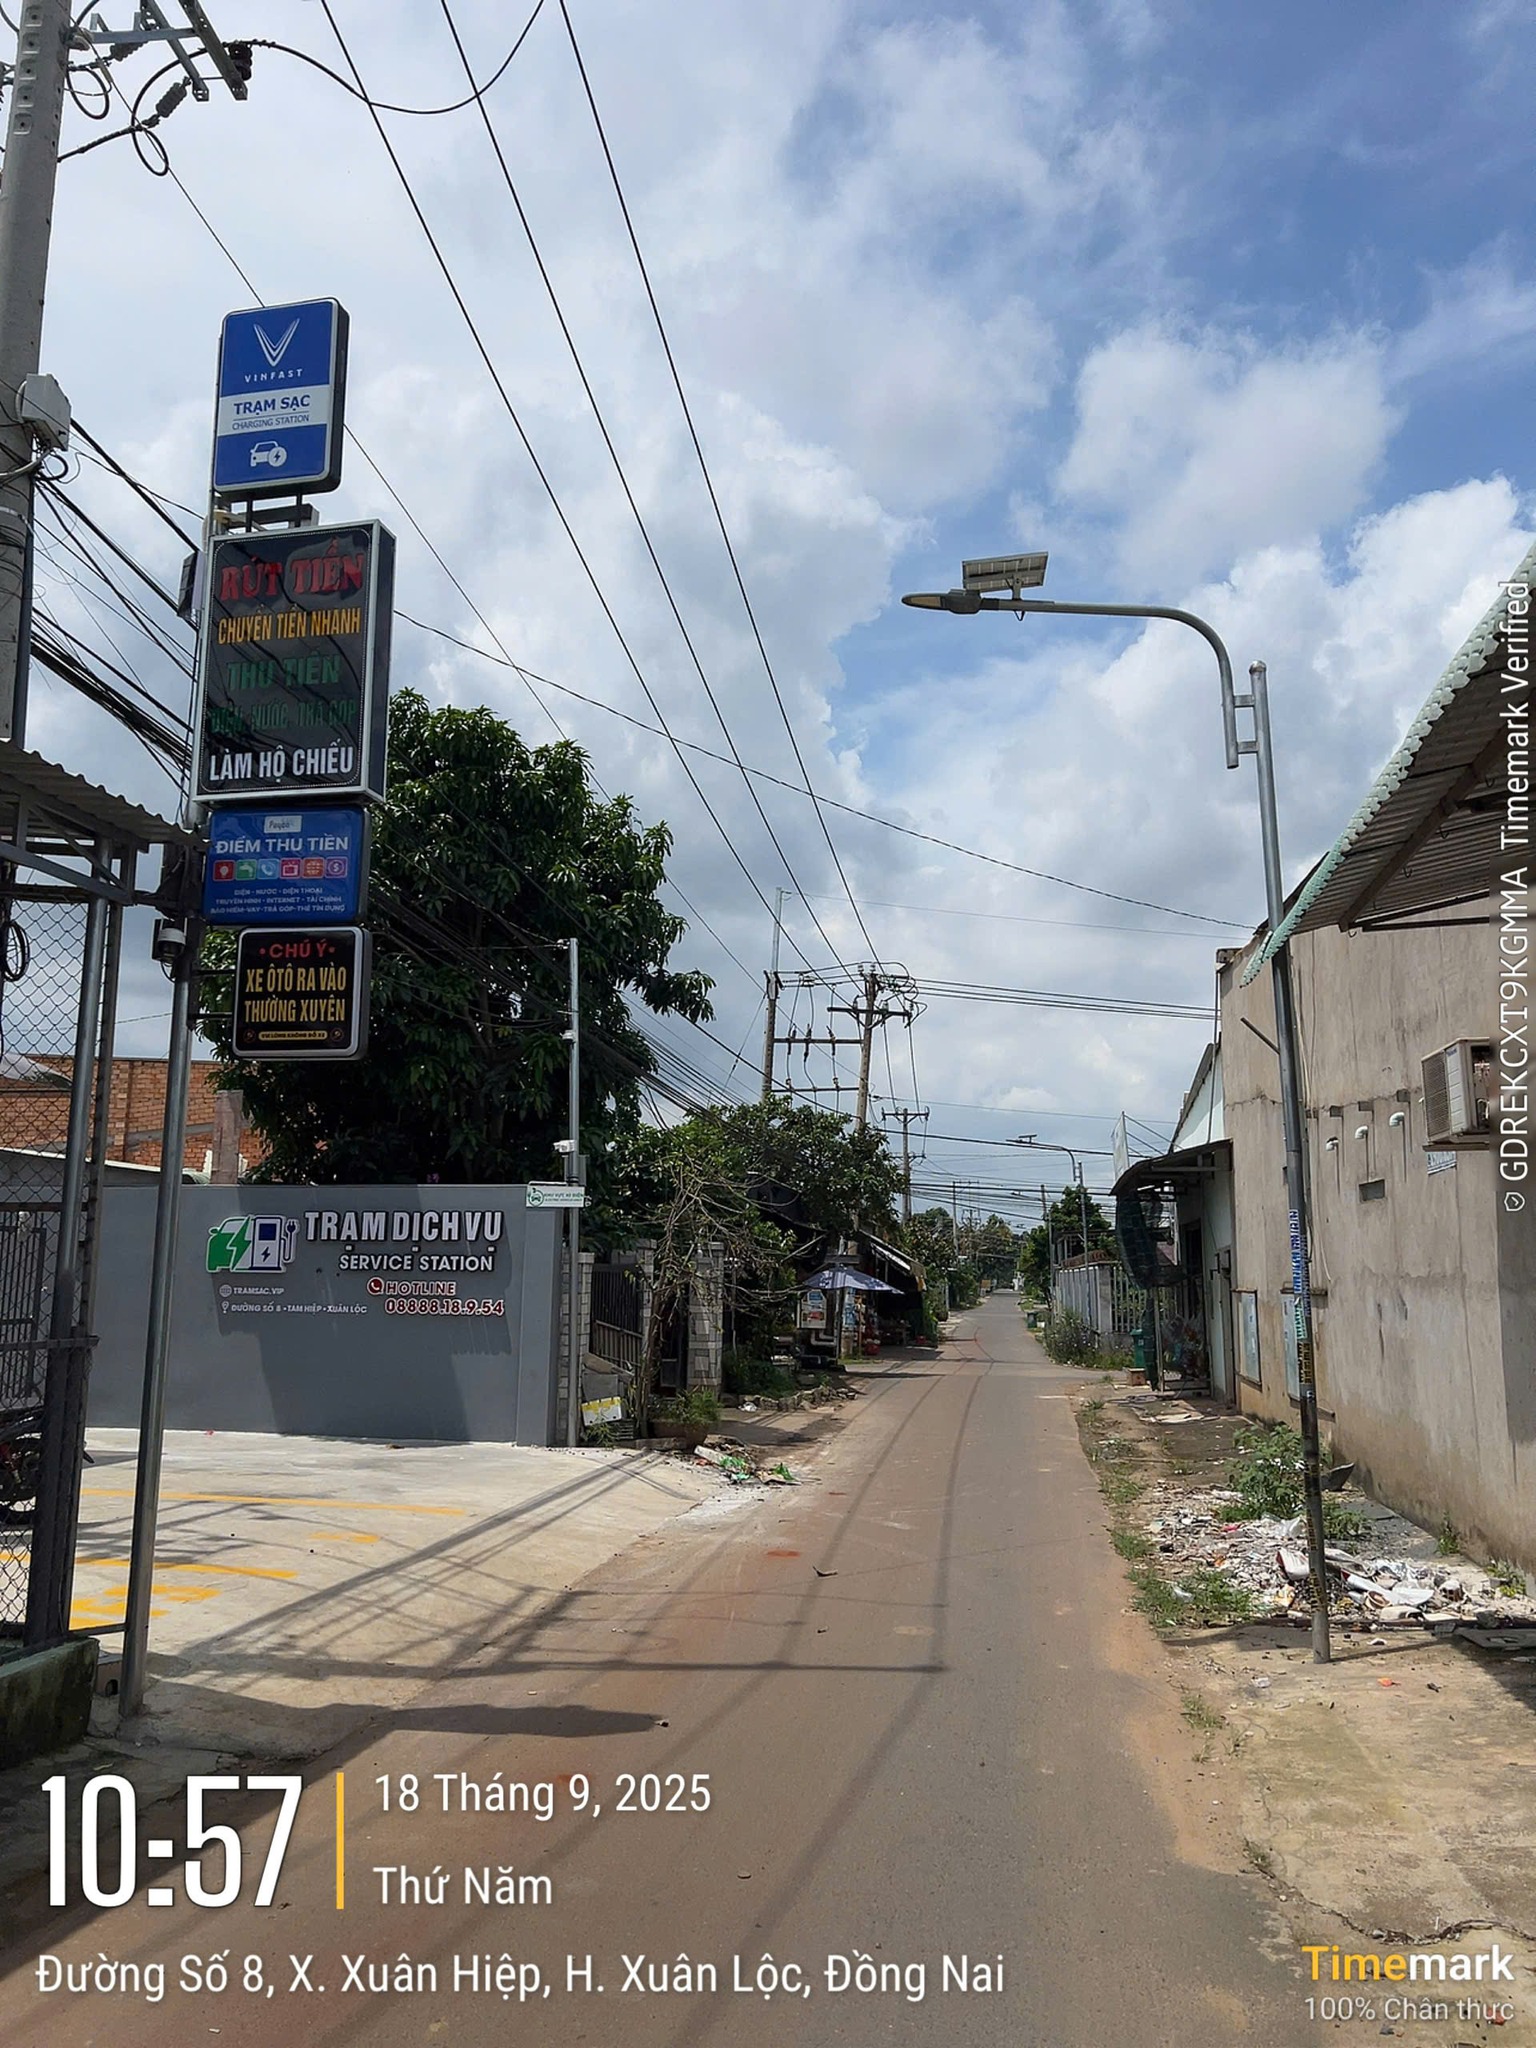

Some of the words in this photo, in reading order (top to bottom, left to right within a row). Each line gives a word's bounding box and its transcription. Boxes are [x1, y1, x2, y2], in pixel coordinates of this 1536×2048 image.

[244, 368, 303, 383] VINFAST
[234, 399, 276, 416] TRẠM
[280, 395, 310, 412] SẠC
[232, 418, 274, 431] CHARGING
[275, 414, 310, 427] STATION
[220, 556, 282, 601] RÚT
[290, 536, 364, 594] TIỀN
[276, 602, 307, 639] TIỀN
[311, 607, 361, 636] NHANH
[227, 659, 276, 691] THU
[209, 748, 253, 781] LÀM
[258, 744, 286, 783] HỘ
[292, 738, 354, 776] CHIẾU
[216, 835, 261, 854] ĐIỂM
[265, 838, 302, 852] THU
[307, 833, 349, 851] TIỀN
[269, 938, 311, 958] CHÚ
[316, 938, 328, 958] Ý
[245, 968, 264, 992] XE
[267, 962, 294, 992] ÔTÔ
[296, 968, 316, 992] RA
[319, 962, 347, 991] VÀO
[244, 994, 296, 1023] THƯỜNG
[300, 994, 346, 1022] XUYÊN
[304, 1211, 386, 1251] TRẠM
[392, 1211, 459, 1252] DỊCH
[464, 1211, 502, 1252] VỤ
[339, 1254, 412, 1270] SERVICE
[419, 1255, 494, 1271] STATION
[386, 1281, 456, 1296] HOTLINE
[231, 1302, 261, 1313] ĐƯỜNG
[262, 1300, 275, 1312] SỐ
[327, 1303, 350, 1313] XUÂN
[350, 1302, 368, 1316] LỘC
[384, 1298, 504, 1316] 08888.18.9.54
